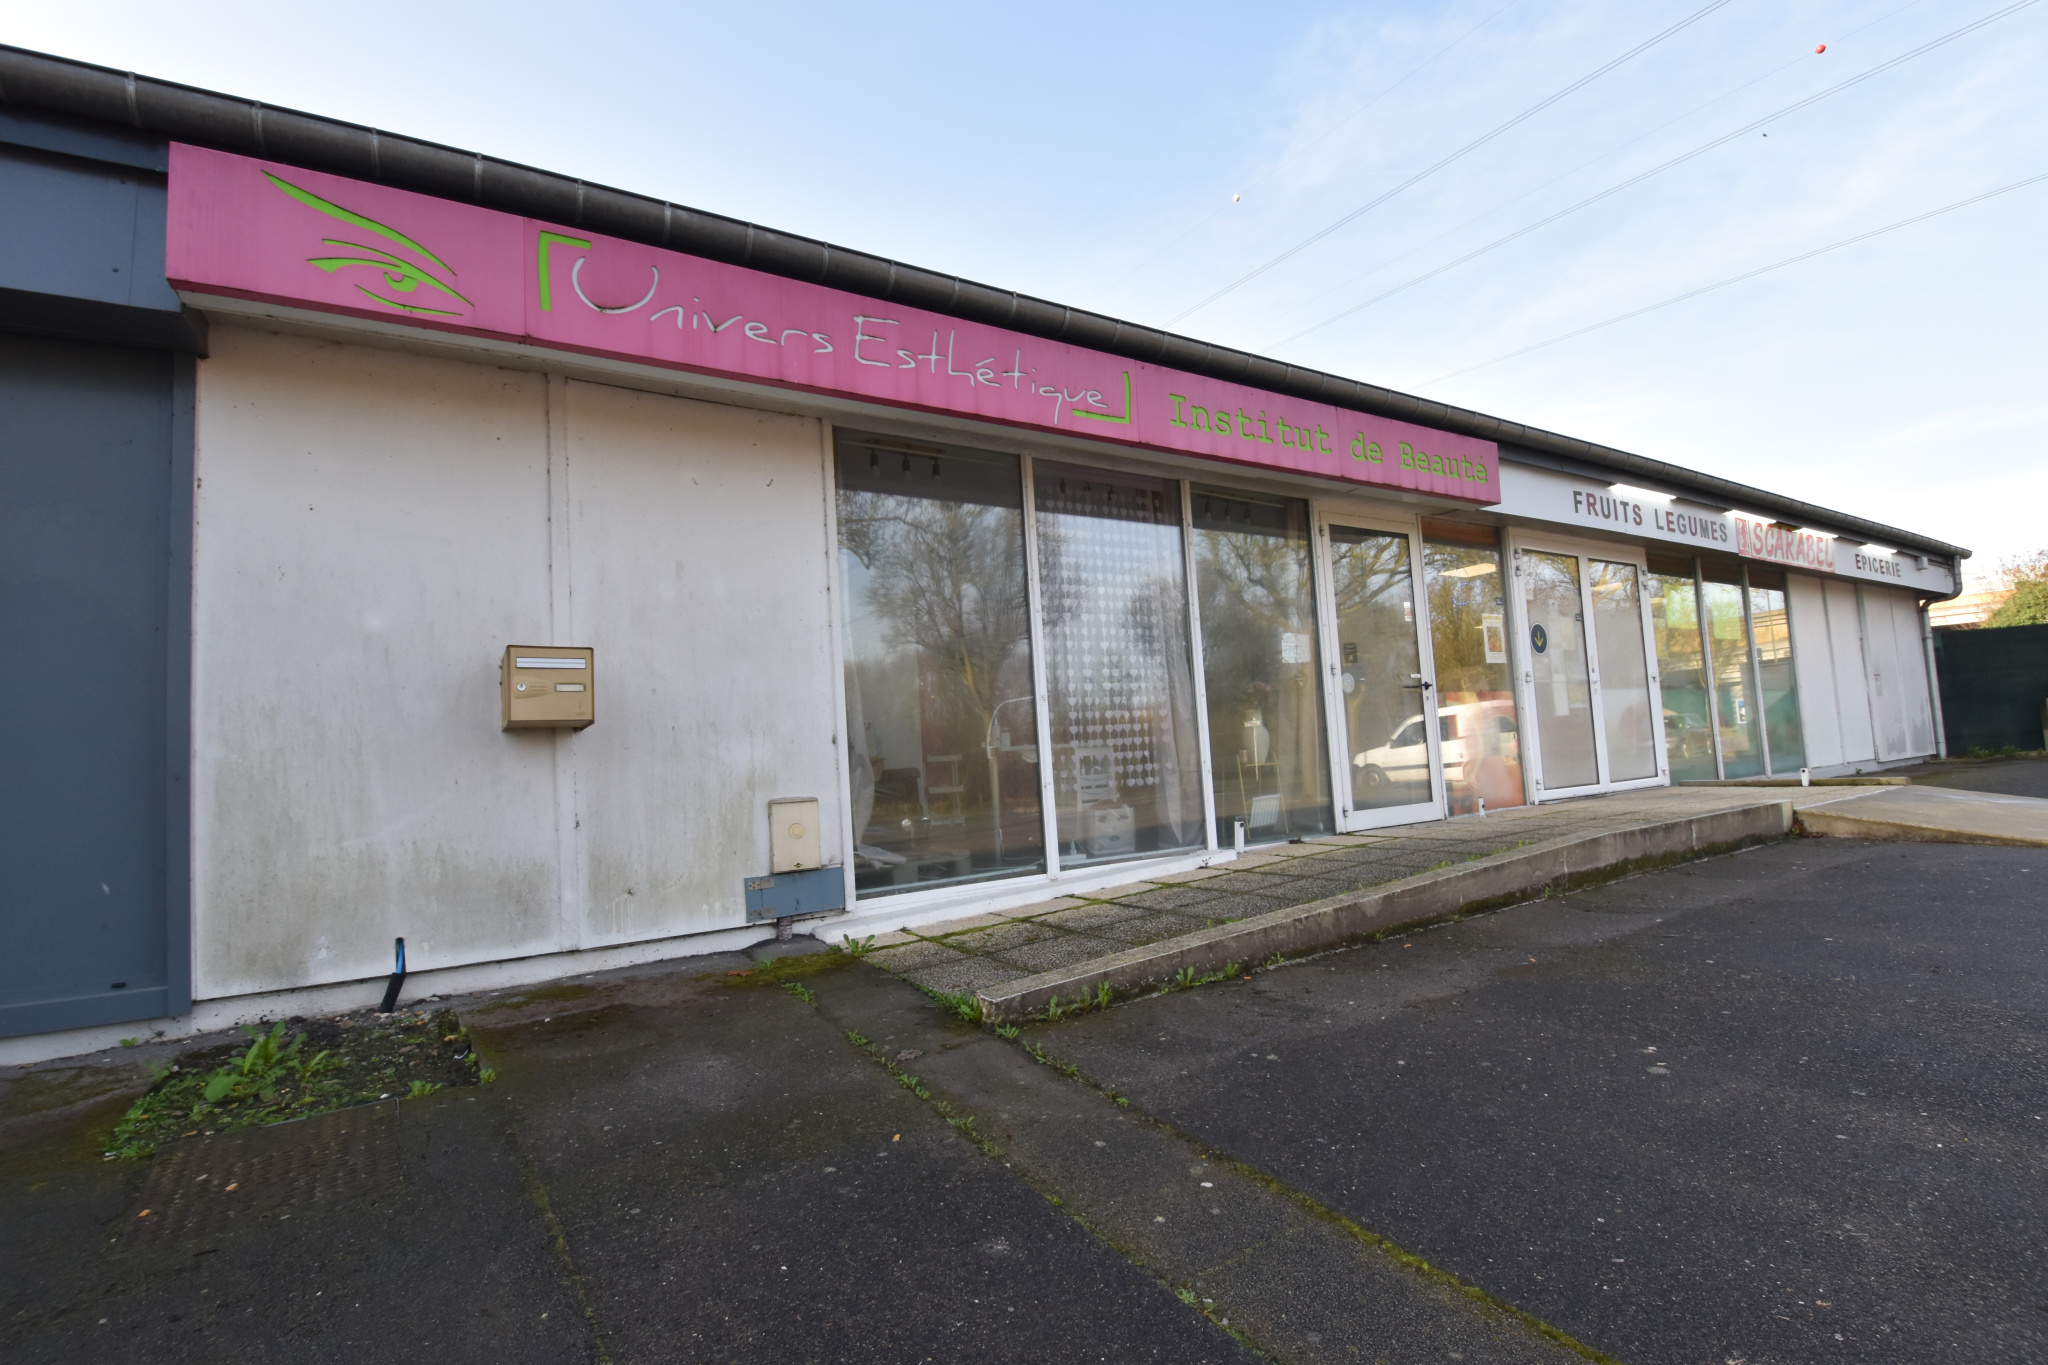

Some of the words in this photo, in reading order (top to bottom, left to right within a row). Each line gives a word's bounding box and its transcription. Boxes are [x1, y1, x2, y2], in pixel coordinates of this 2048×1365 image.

[571, 256, 834, 353] Univers
[1168, 393, 1332, 455] Institut
[1350, 431, 1384, 465] de
[1398, 441, 1488, 484] Beauté
[1573, 490, 1643, 526] FRUITS
[1654, 508, 1728, 543] LEGUMES
[1752, 522, 1833, 568] SCARABEL
[1854, 553, 1902, 578] EPICERIE
